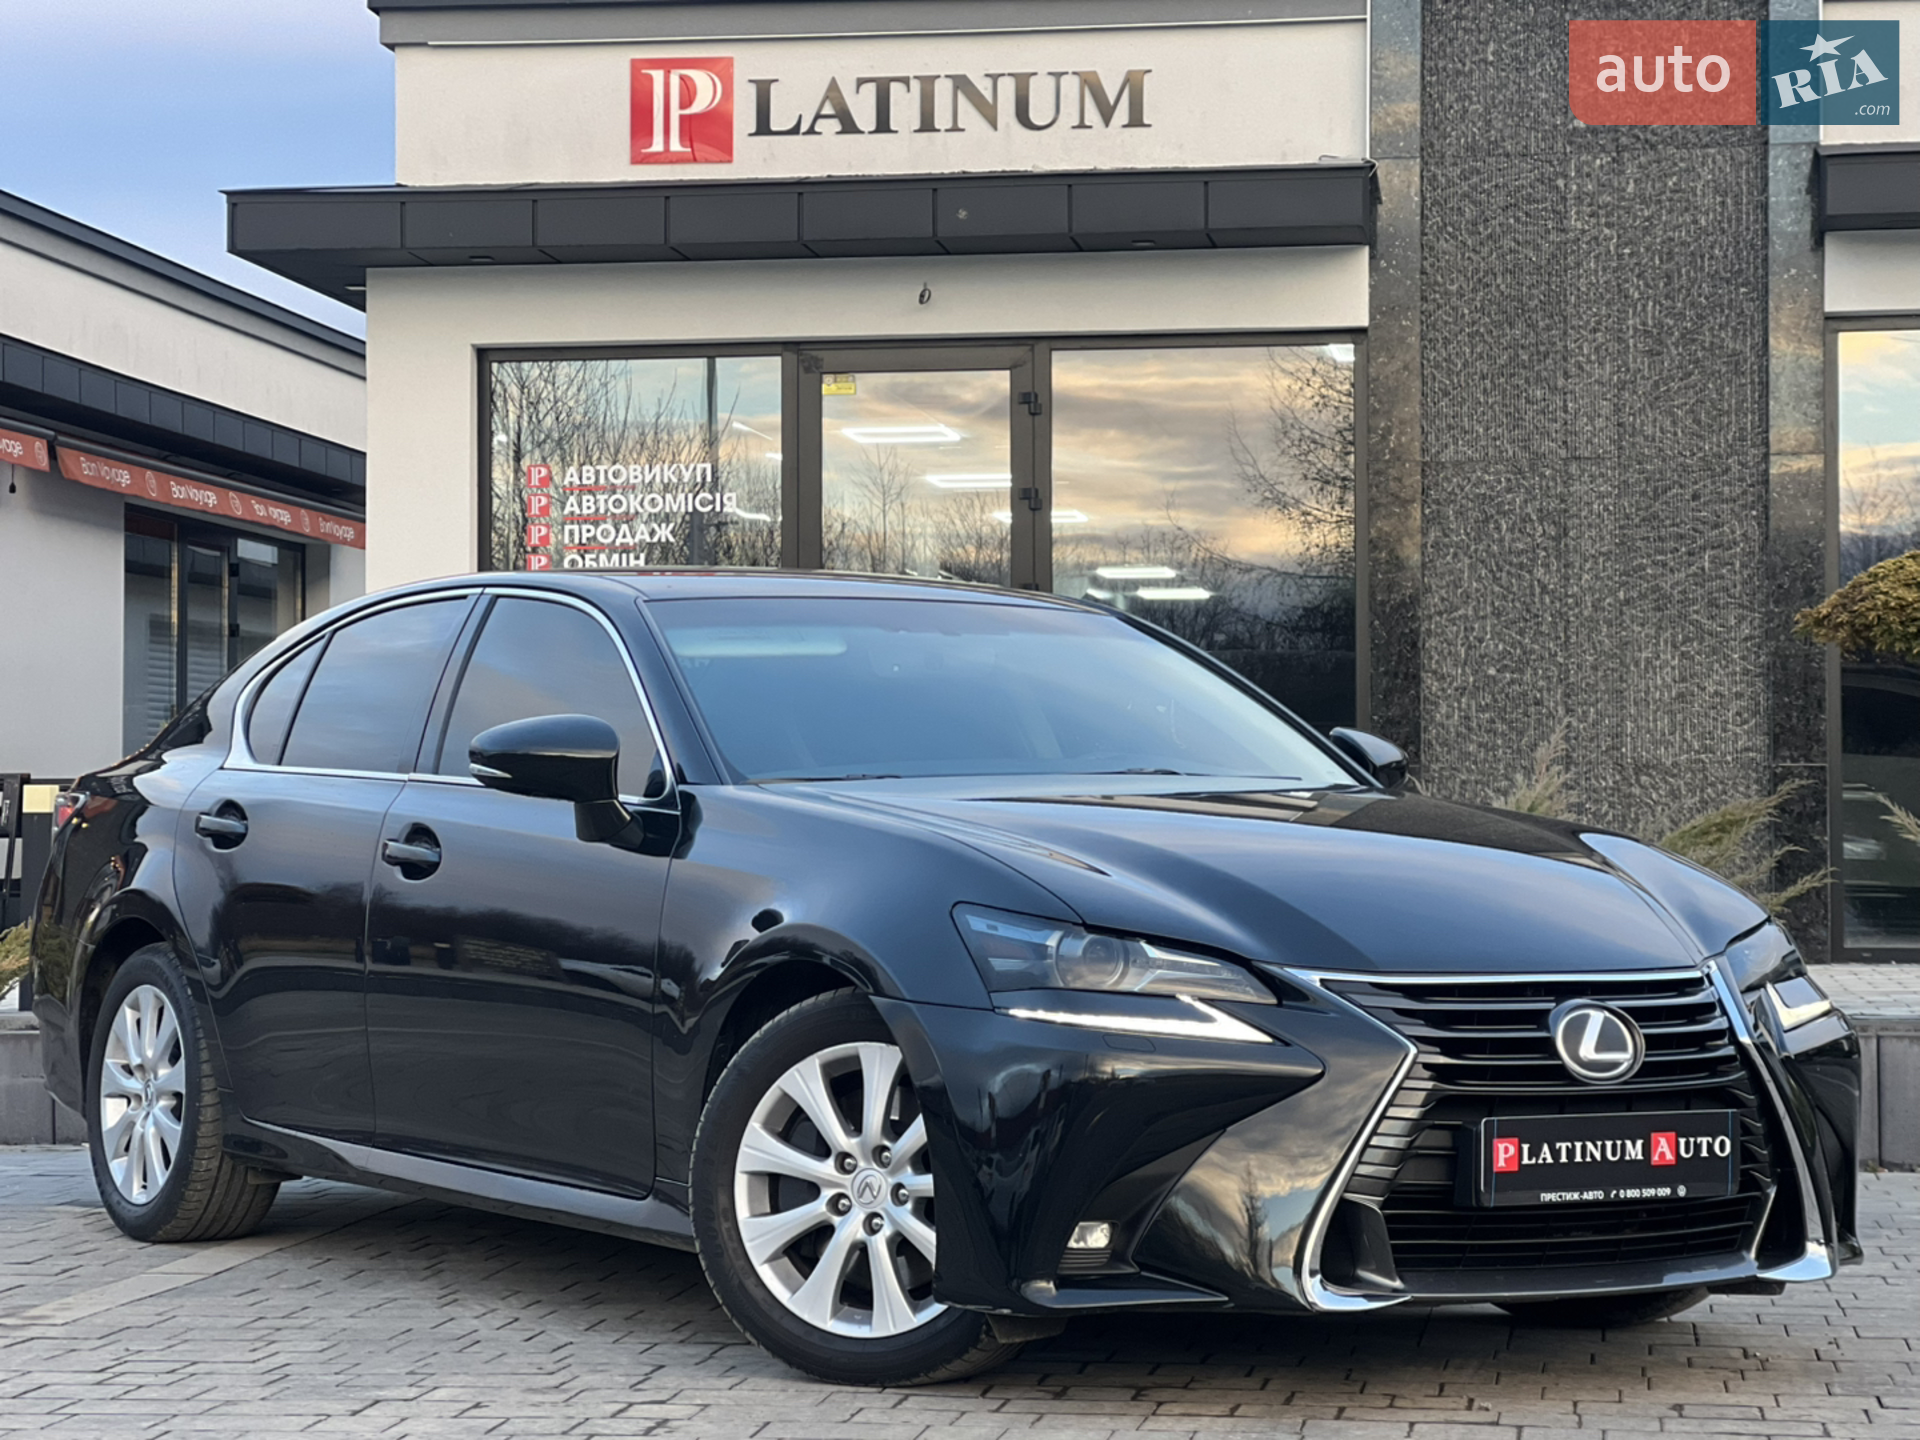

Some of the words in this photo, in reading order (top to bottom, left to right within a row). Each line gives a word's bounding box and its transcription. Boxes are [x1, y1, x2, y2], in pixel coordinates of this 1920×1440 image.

[563, 463, 713, 485] АВТОВИКУП
[169, 481, 188, 499] Bon
[185, 484, 218, 508] Voyage
[563, 492, 737, 515] АВТОКОМІСІЯ
[563, 522, 676, 546] ПРОДАЖ
[563, 553, 646, 568] ОБМІН
[1496, 1139, 1645, 1168] PLATINUM
[1653, 1135, 1732, 1162] AUTO
[1540, 1189, 1605, 1202] ПРЕСТИЖ-АВТО
